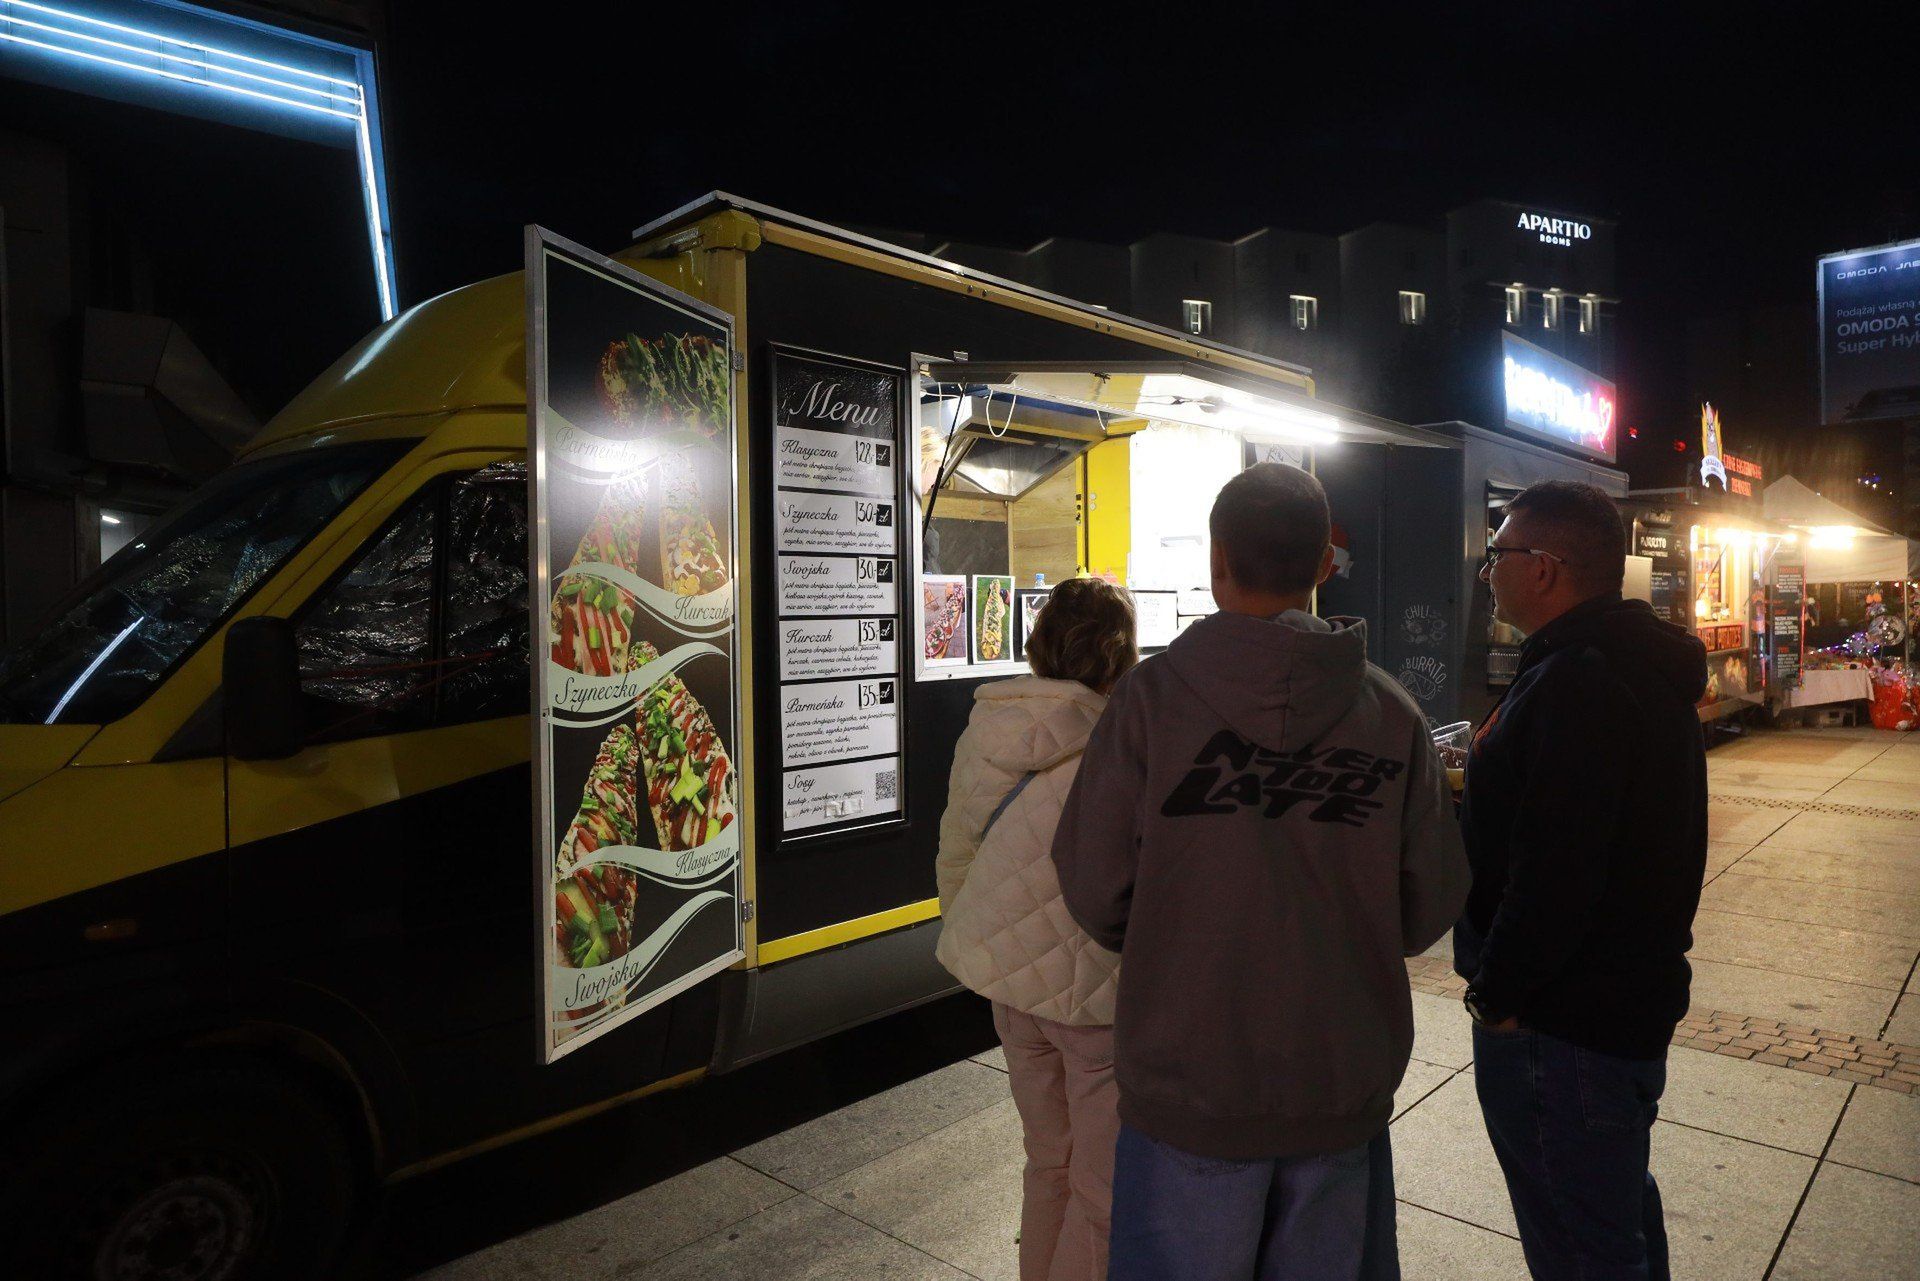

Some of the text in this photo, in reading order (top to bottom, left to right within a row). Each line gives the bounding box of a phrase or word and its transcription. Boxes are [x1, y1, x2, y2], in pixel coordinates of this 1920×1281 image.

[1518, 212, 1591, 240] APARTIO
[1540, 234, 1571, 246] ROOMS
[1837, 266, 1888, 280] OMODA
[1837, 315, 1909, 337] OMODA
[1837, 339, 1886, 354] Super
[789, 381, 883, 426] Menu
[555, 426, 639, 464] Parmeńska
[781, 440, 839, 460] Klasyczna
[783, 504, 839, 523] Szyneczka
[783, 560, 830, 579] Swojska
[674, 594, 731, 622] Kurczak
[1405, 605, 1429, 620] CHILI
[786, 629, 834, 643] Kurczak
[880, 623, 892, 637] zł
[1405, 656, 1447, 685] BURRITO
[555, 676, 639, 712] Szyneczka
[785, 695, 845, 713] Parmeńska
[880, 684, 891, 699] zł
[788, 774, 816, 792] Sosy
[1254, 758, 1383, 797] TOO
[1161, 766, 1384, 828] LATE
[675, 845, 732, 876] Klasyczna
[565, 953, 640, 1008] Swojska
